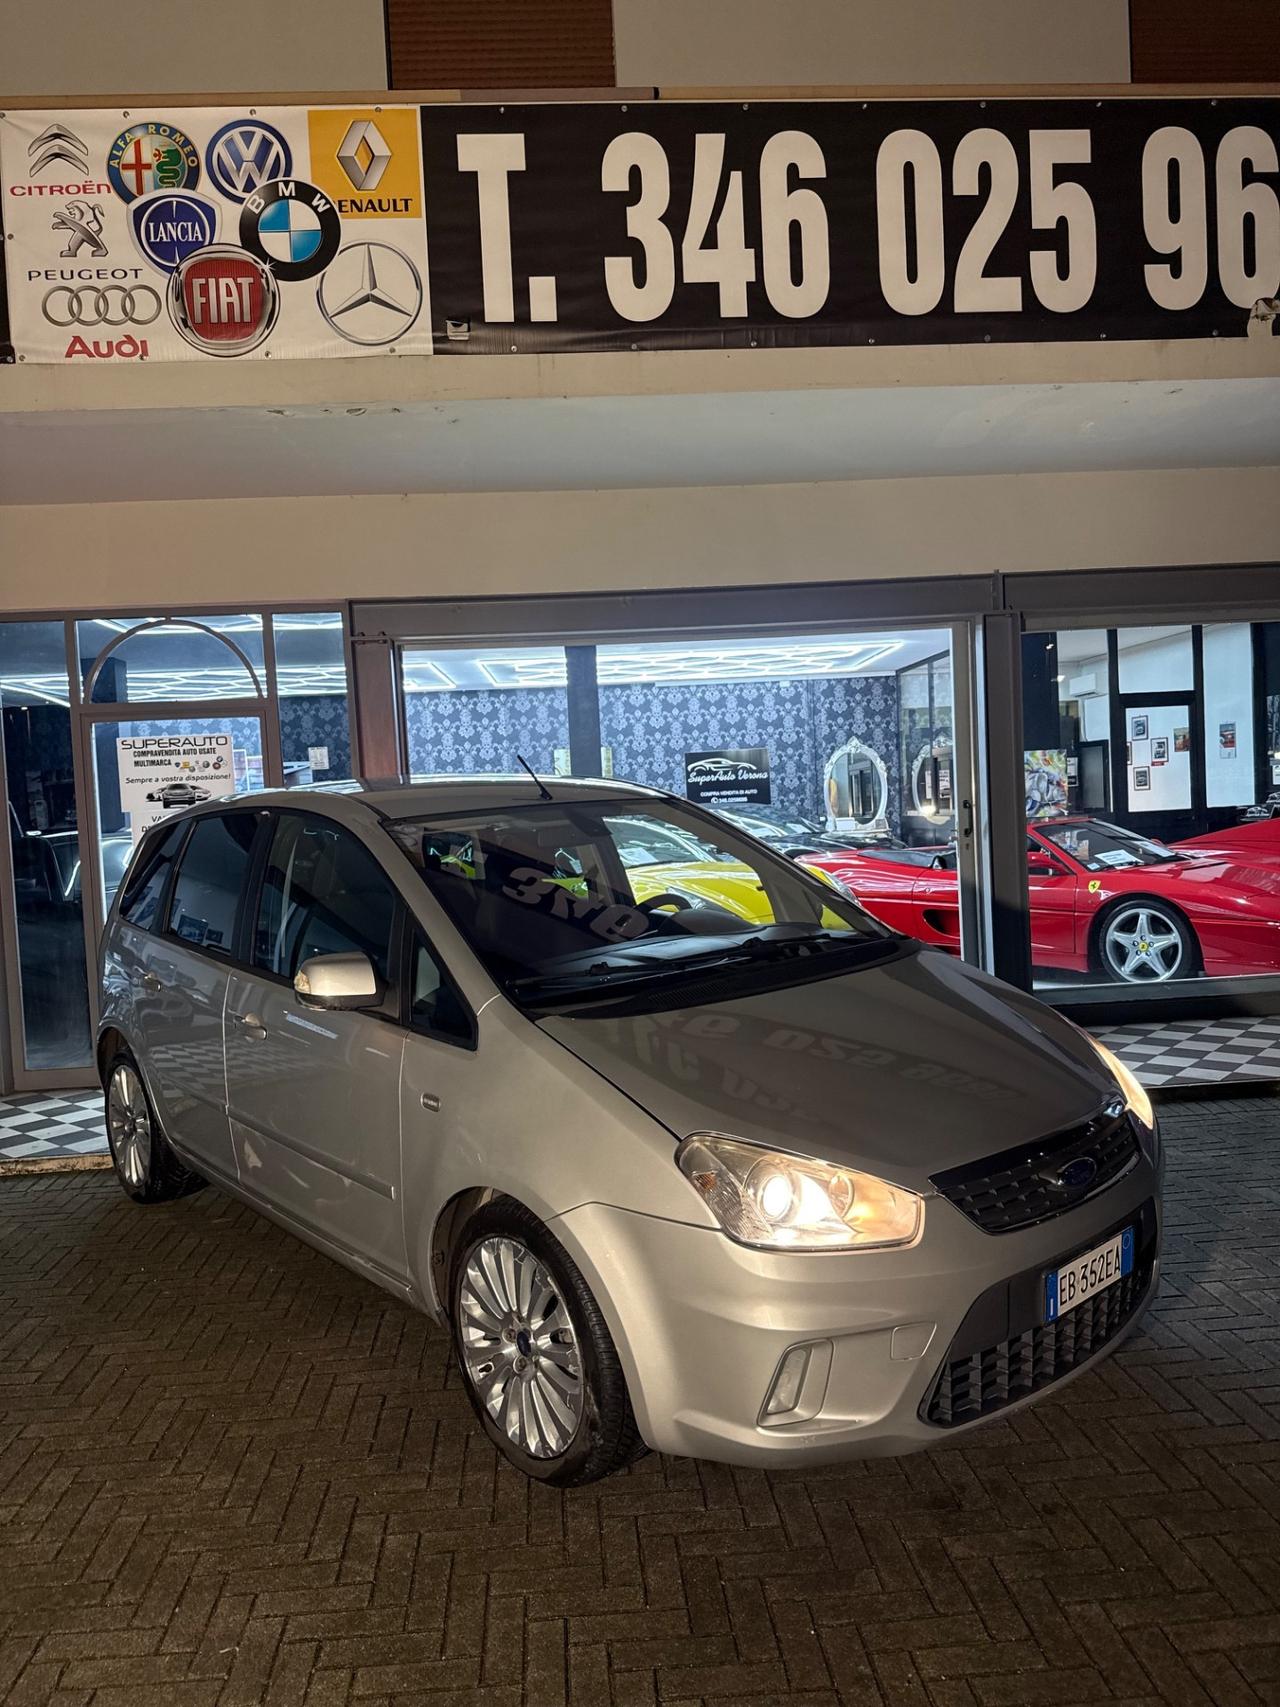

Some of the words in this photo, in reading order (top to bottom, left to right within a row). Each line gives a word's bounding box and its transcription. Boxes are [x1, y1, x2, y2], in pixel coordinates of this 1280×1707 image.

[110, 132, 135, 168] ALFA
[148, 124, 198, 167] ROMEO
[248, 182, 331, 214] BMW
[337, 198, 413, 213] ENAULT
[149, 220, 203, 243] LANCIA
[457, 133, 558, 323] T.
[602, 132, 830, 322] 346
[876, 128, 1096, 316] 025
[1142, 125, 1280, 314] 96
[28, 268, 143, 281] PEUGEOT
[192, 277, 254, 324] FIAT
[65, 334, 149, 358] Audi
[122, 736, 228, 749] SUPERAUTO
[133, 749, 181, 758] COMPRAVENDITA
[198, 747, 216, 755] USATE
[134, 759, 171, 767] MULTIMARCA
[125, 776, 152, 785] Sempre
[161, 774, 183, 782] vostra
[185, 773, 231, 783] disposizione!
[1059, 1270, 1076, 1306] EB
[1080, 1245, 1121, 1294] 352EA
